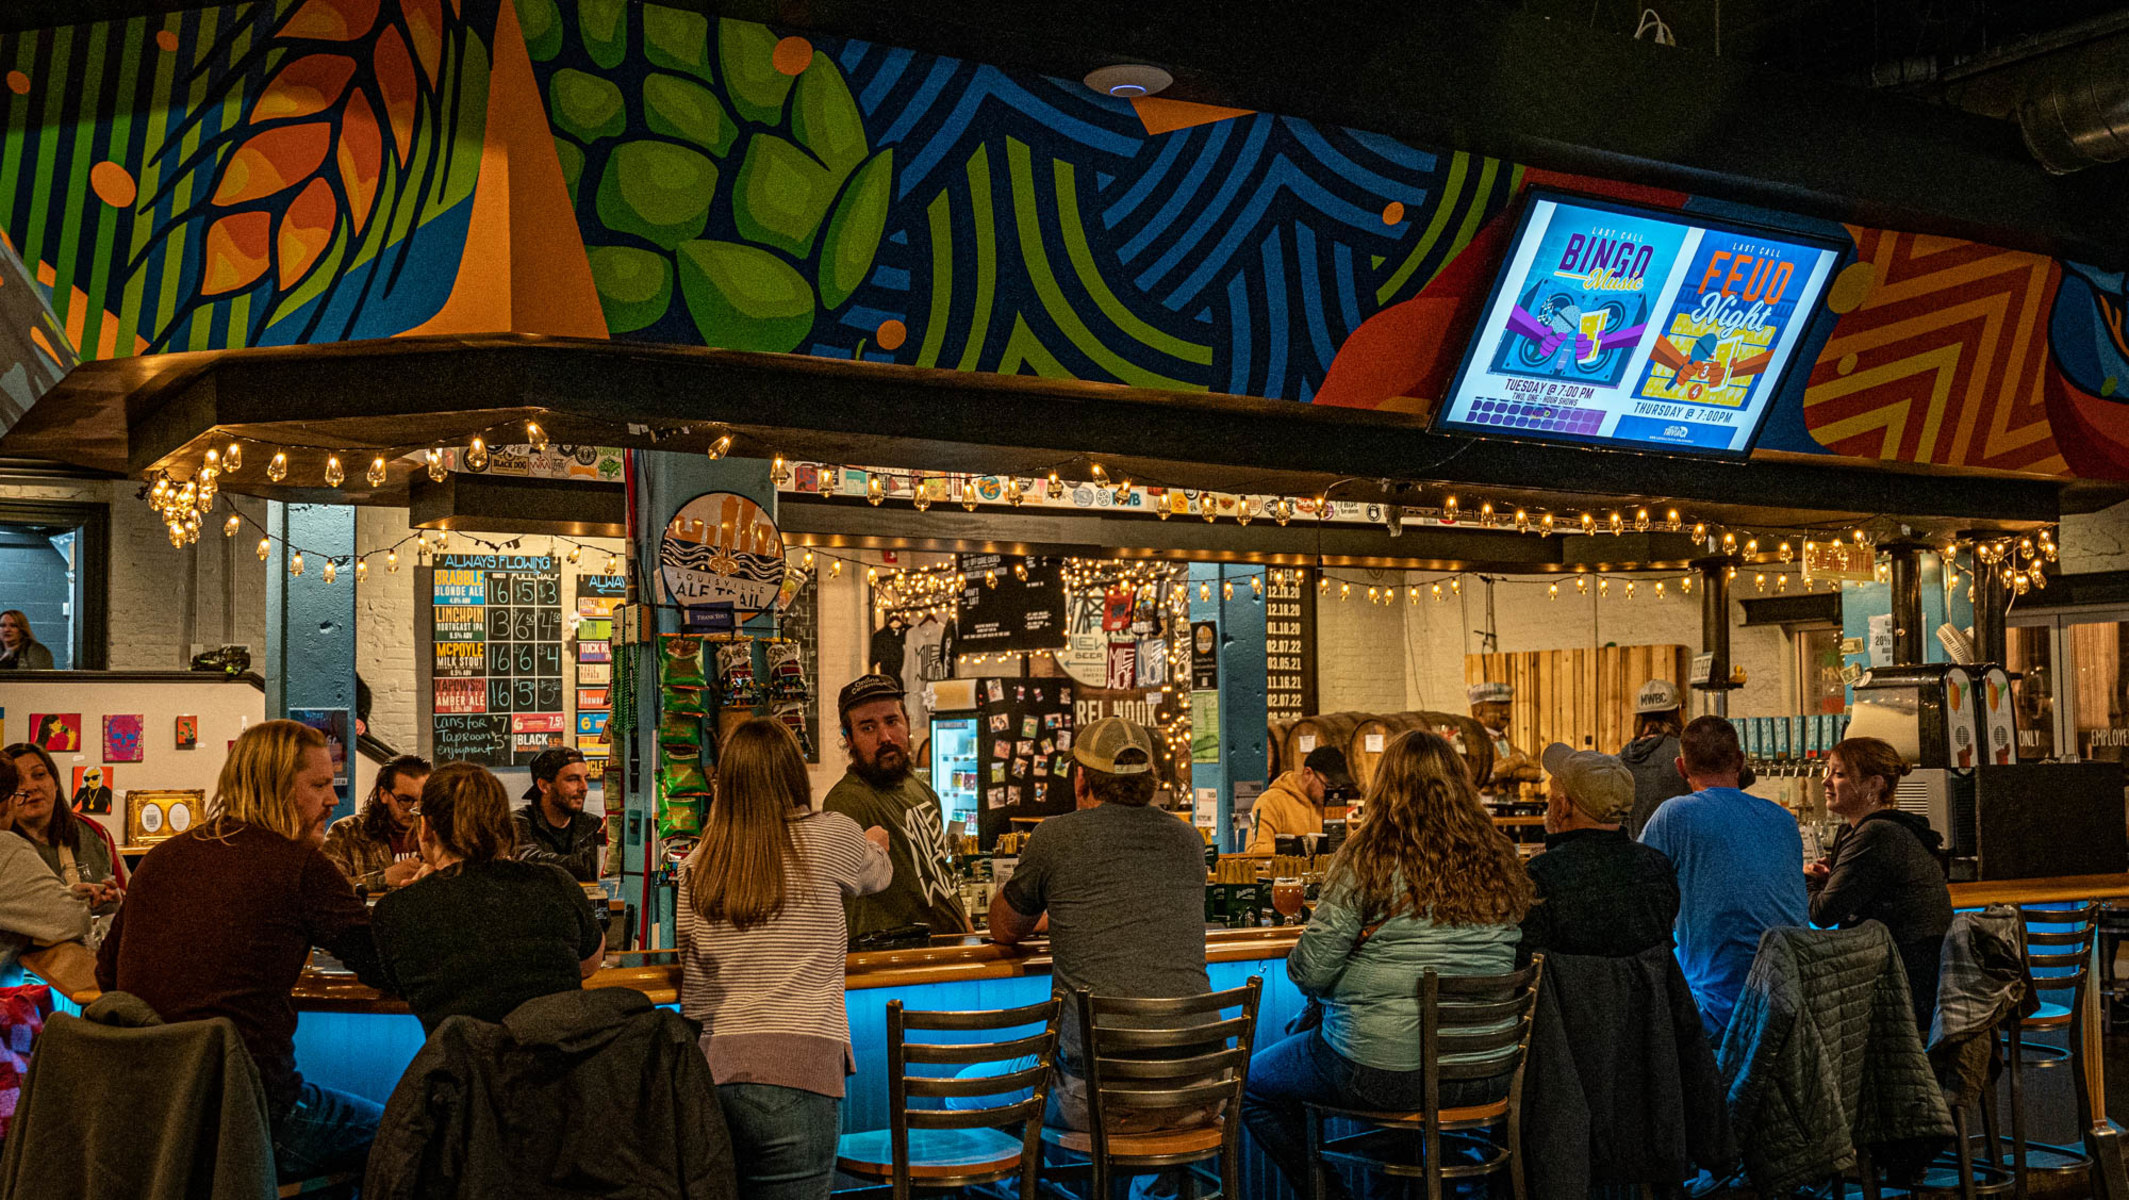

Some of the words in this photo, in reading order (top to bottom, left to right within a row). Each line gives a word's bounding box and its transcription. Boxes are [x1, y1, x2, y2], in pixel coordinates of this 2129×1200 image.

[1591, 226, 1616, 238] LAST
[1620, 231, 1644, 243] CALL
[1558, 232, 1654, 280] BINGO
[1732, 242, 1756, 253] LAST
[1759, 246, 1781, 258] CALL
[1582, 267, 1644, 291] Music
[1697, 250, 1795, 305] FEUD
[1690, 291, 1772, 338] Night
[1700, 365, 1709, 378] 3
[1505, 379, 1548, 396] TUESDAY
[1547, 384, 1558, 396] @
[1557, 385, 1579, 398] 7:00
[1579, 388, 1595, 399] PM
[1691, 387, 1699, 398] 4
[1633, 401, 1684, 419] THURSDAY
[1684, 408, 1695, 419] @
[1696, 409, 1734, 423] 7:00PM
[493, 459, 513, 469] BLACK
[513, 460, 527, 470] DOG
[444, 554, 497, 569] ALWAYS
[498, 555, 551, 569] FLOWING
[434, 570, 484, 586] BRABBLE
[589, 575, 626, 588] ALWAY
[676, 572, 765, 594] LOUISVILLE
[434, 585, 466, 597] BLONDE
[468, 585, 484, 597] ALE
[489, 580, 509, 604] 16
[435, 607, 484, 623] LINCHPIN
[1266, 603, 1301, 617] 12.18.20
[490, 610, 510, 637] 13
[1266, 621, 1301, 635] 01.10.20
[580, 643, 599, 653] TUCK
[1266, 639, 1301, 654] 02.07.22
[436, 656, 458, 667] MILK
[459, 656, 484, 667] STOUT
[492, 646, 510, 671] 16
[1075, 652, 1103, 660] BEER
[1266, 657, 1301, 671] 03.05.21
[1266, 675, 1301, 690] 11.16.21
[435, 696, 466, 707] AMBER
[468, 696, 485, 707] ALE
[491, 681, 510, 707] 16
[1266, 693, 1301, 708] 02.07.22
[1640, 692, 1667, 706] MWBC
[580, 717, 591, 730] 6
[517, 734, 549, 746] BLACK
[2019, 729, 2040, 747] ONLY
